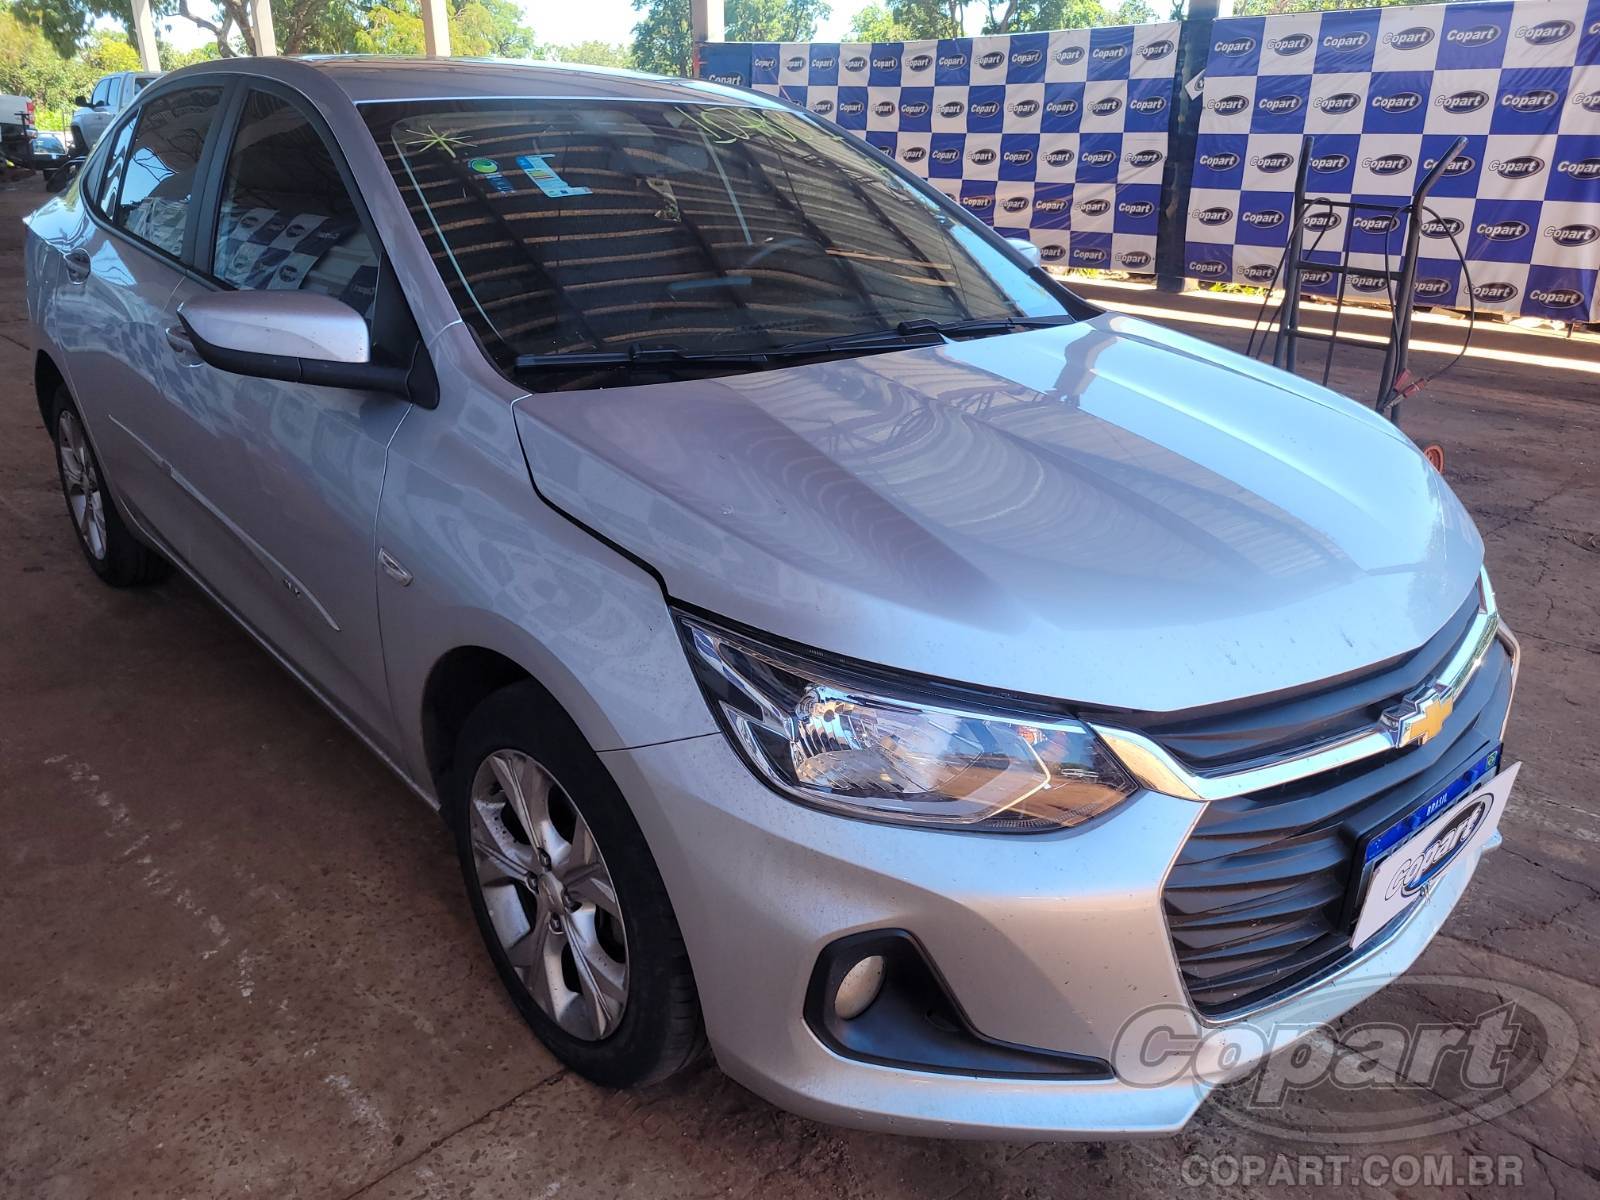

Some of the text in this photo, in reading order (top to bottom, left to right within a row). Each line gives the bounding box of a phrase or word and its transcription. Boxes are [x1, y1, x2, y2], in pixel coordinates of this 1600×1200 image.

[1447, 27, 1495, 43] Copart
[1516, 22, 1568, 40] Copart
[1267, 37, 1307, 50] Copart
[1323, 34, 1365, 48] Copart
[1383, 30, 1428, 45] Copart
[1136, 44, 1169, 57] Copart
[1215, 41, 1250, 53] Copart
[1011, 52, 1040, 63] Copart
[1092, 48, 1123, 60] Copart
[754, 58, 775, 69] Copart
[811, 58, 833, 69] Copart
[873, 59, 894, 68] Copart
[939, 56, 964, 67] Copart
[1130, 99, 1163, 111] Copart
[1207, 98, 1244, 111] Copart
[1259, 98, 1297, 110] Copart
[1313, 95, 1354, 109] Copart
[1372, 95, 1416, 110] Copart
[1434, 93, 1482, 110] Copart
[1501, 91, 1552, 108] Copart
[1572, 92, 1600, 107] Cop
[839, 103, 861, 112] Copart
[901, 104, 926, 113] Copart
[971, 104, 997, 113] Copart
[1046, 101, 1075, 112] Copart
[1087, 100, 1117, 112] Copart
[932, 150, 957, 160] Copart
[1004, 152, 1031, 161] Copart
[1041, 151, 1070, 162] Copart
[1082, 152, 1113, 163] Copart
[1125, 152, 1157, 163] Copart
[1200, 155, 1235, 167] Copart
[1250, 155, 1288, 168] Copart
[1311, 157, 1345, 169] opart
[1361, 157, 1405, 170] Copart
[1423, 158, 1469, 171] Cart
[1488, 159, 1537, 174] Copart
[1557, 160, 1600, 175] Copar
[962, 197, 989, 207] Copart
[1036, 200, 1065, 211] Copart
[1119, 203, 1150, 213] Copart
[1192, 209, 1228, 221] Copart
[1242, 212, 1280, 224] Copart
[1353, 217, 1389, 229] Copar
[1476, 223, 1522, 237] Copart
[1543, 225, 1592, 241] Copart
[1073, 249, 1103, 260] Copart
[1189, 261, 1223, 273] Copart
[1237, 266, 1273, 278] Copart
[1301, 272, 1327, 282] part
[1529, 289, 1577, 304] Copart
[1384, 800, 1484, 902] Copart
